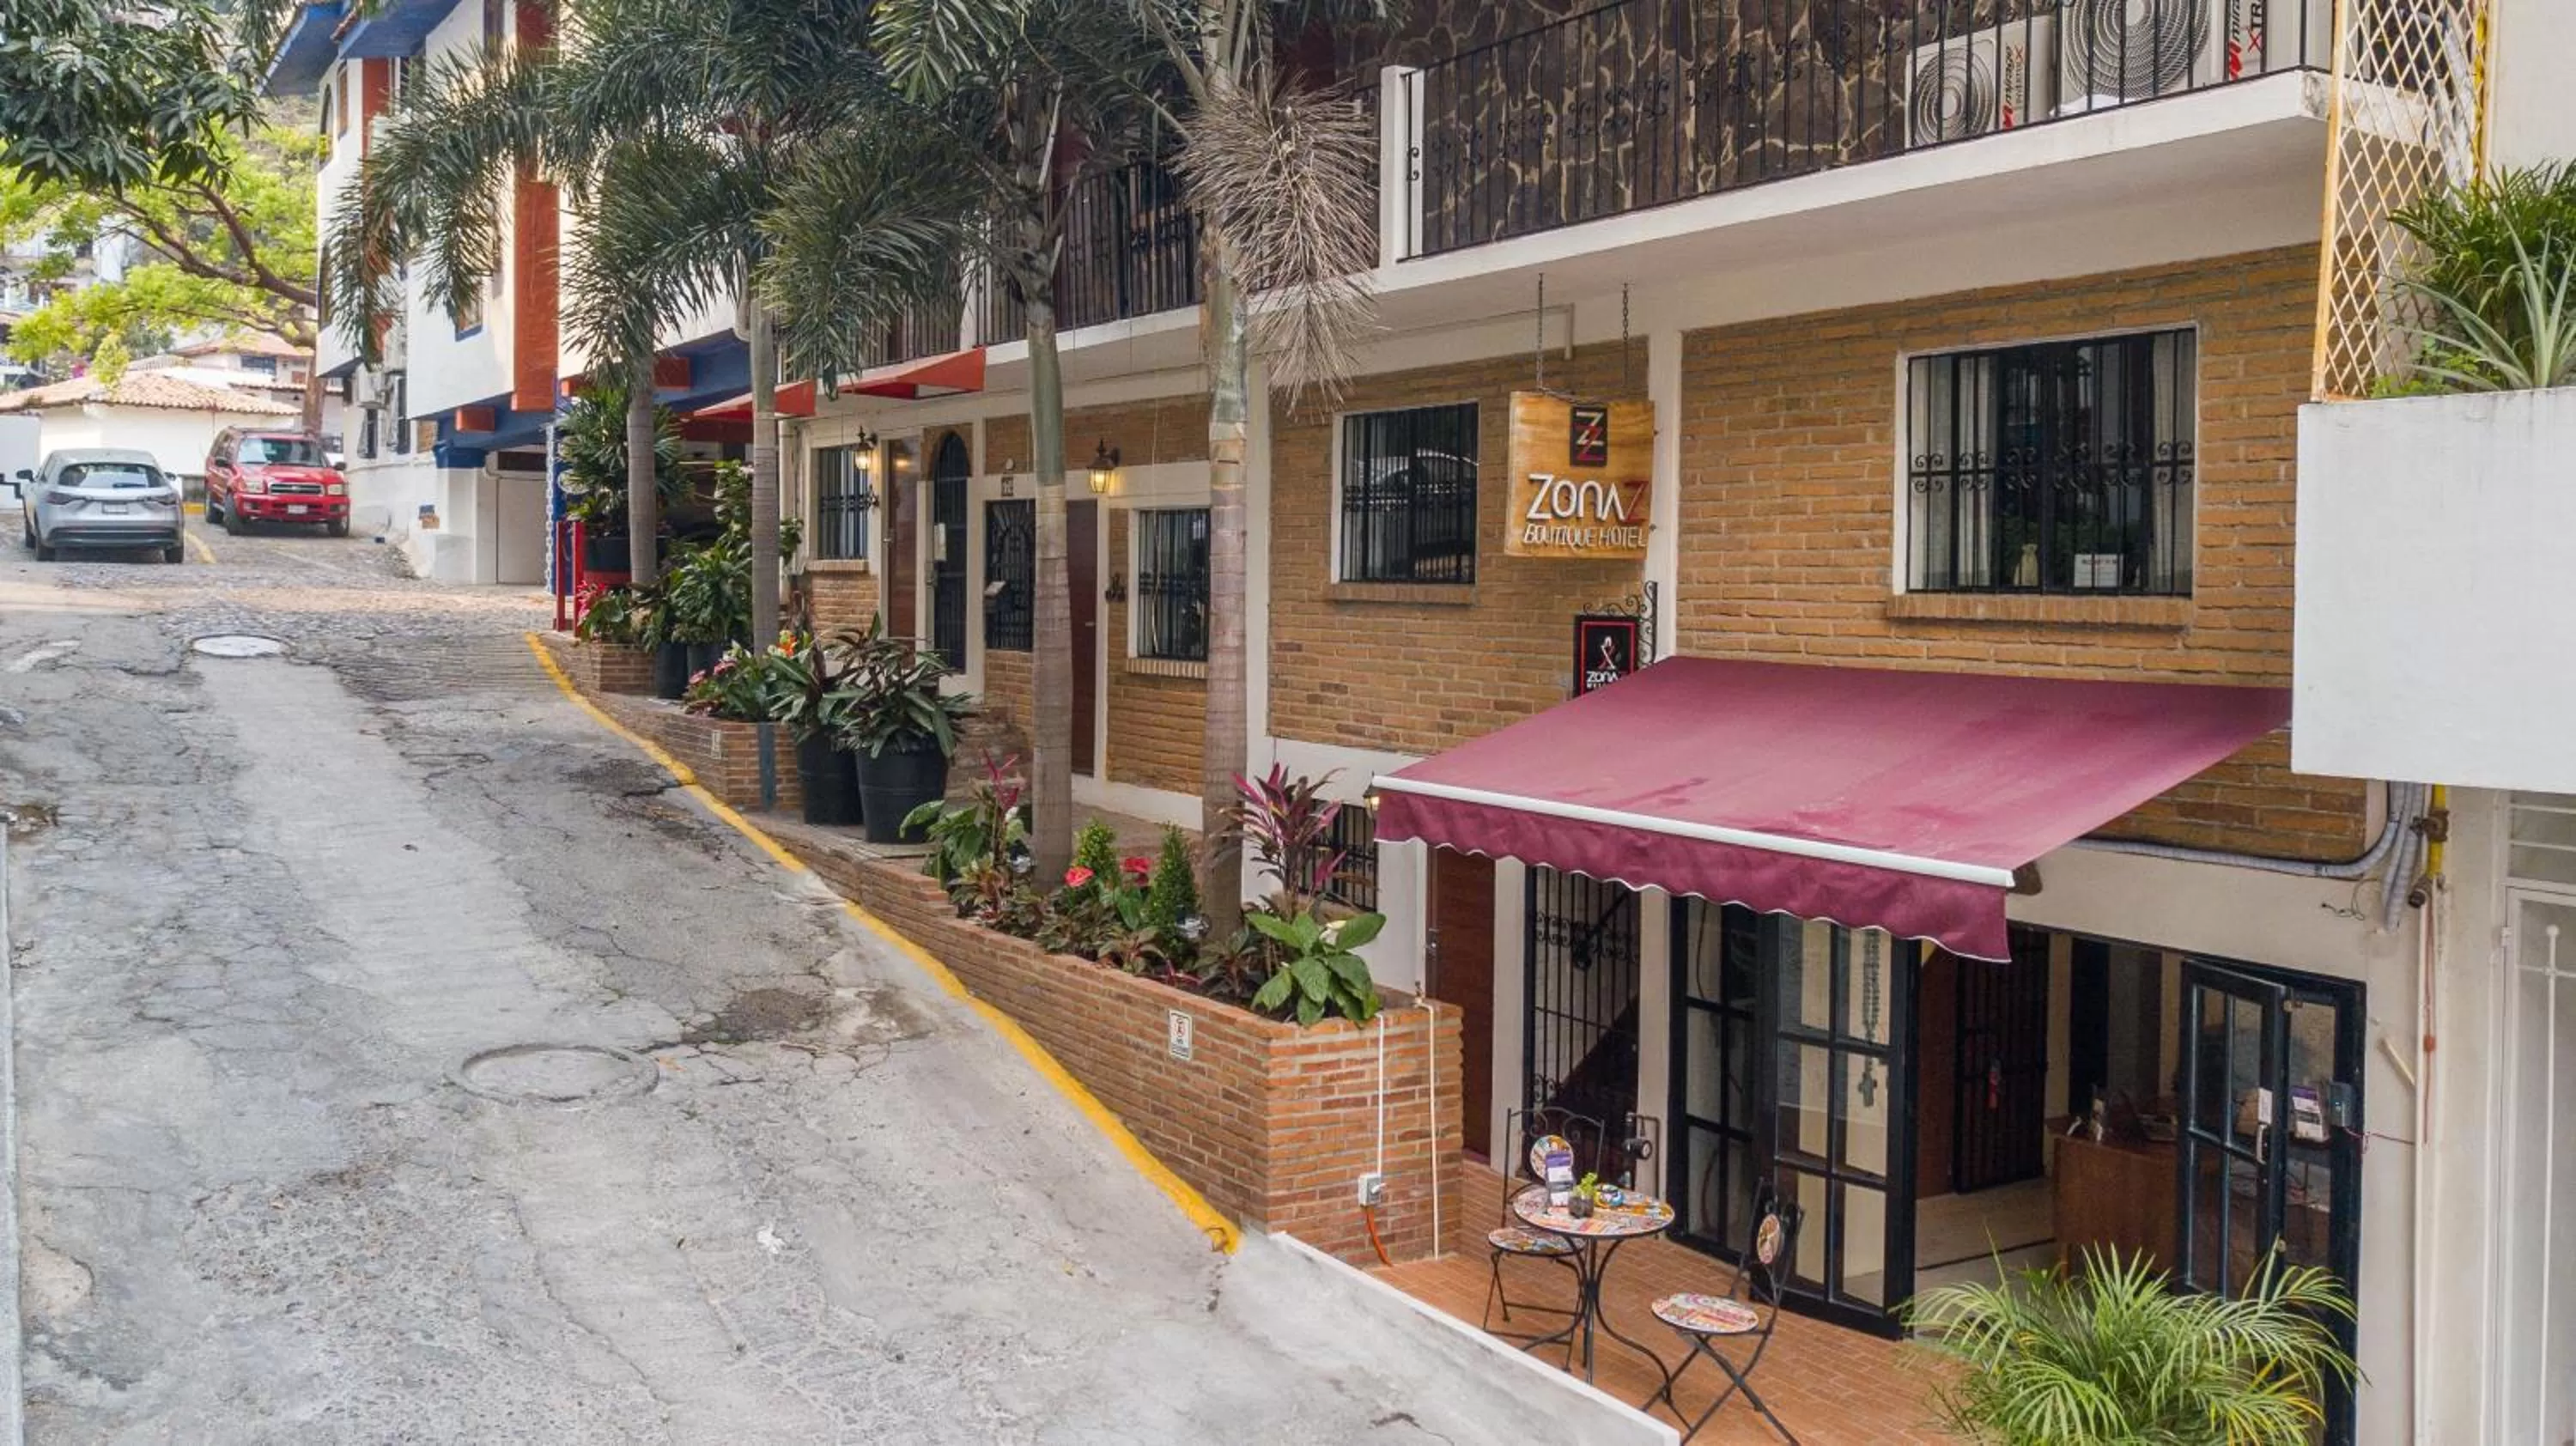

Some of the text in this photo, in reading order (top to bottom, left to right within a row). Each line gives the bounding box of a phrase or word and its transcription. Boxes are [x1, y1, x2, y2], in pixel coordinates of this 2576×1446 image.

[2247, 0, 2263, 52] XTR
[1524, 523, 1647, 551] BOUTIQUE HOTEL
